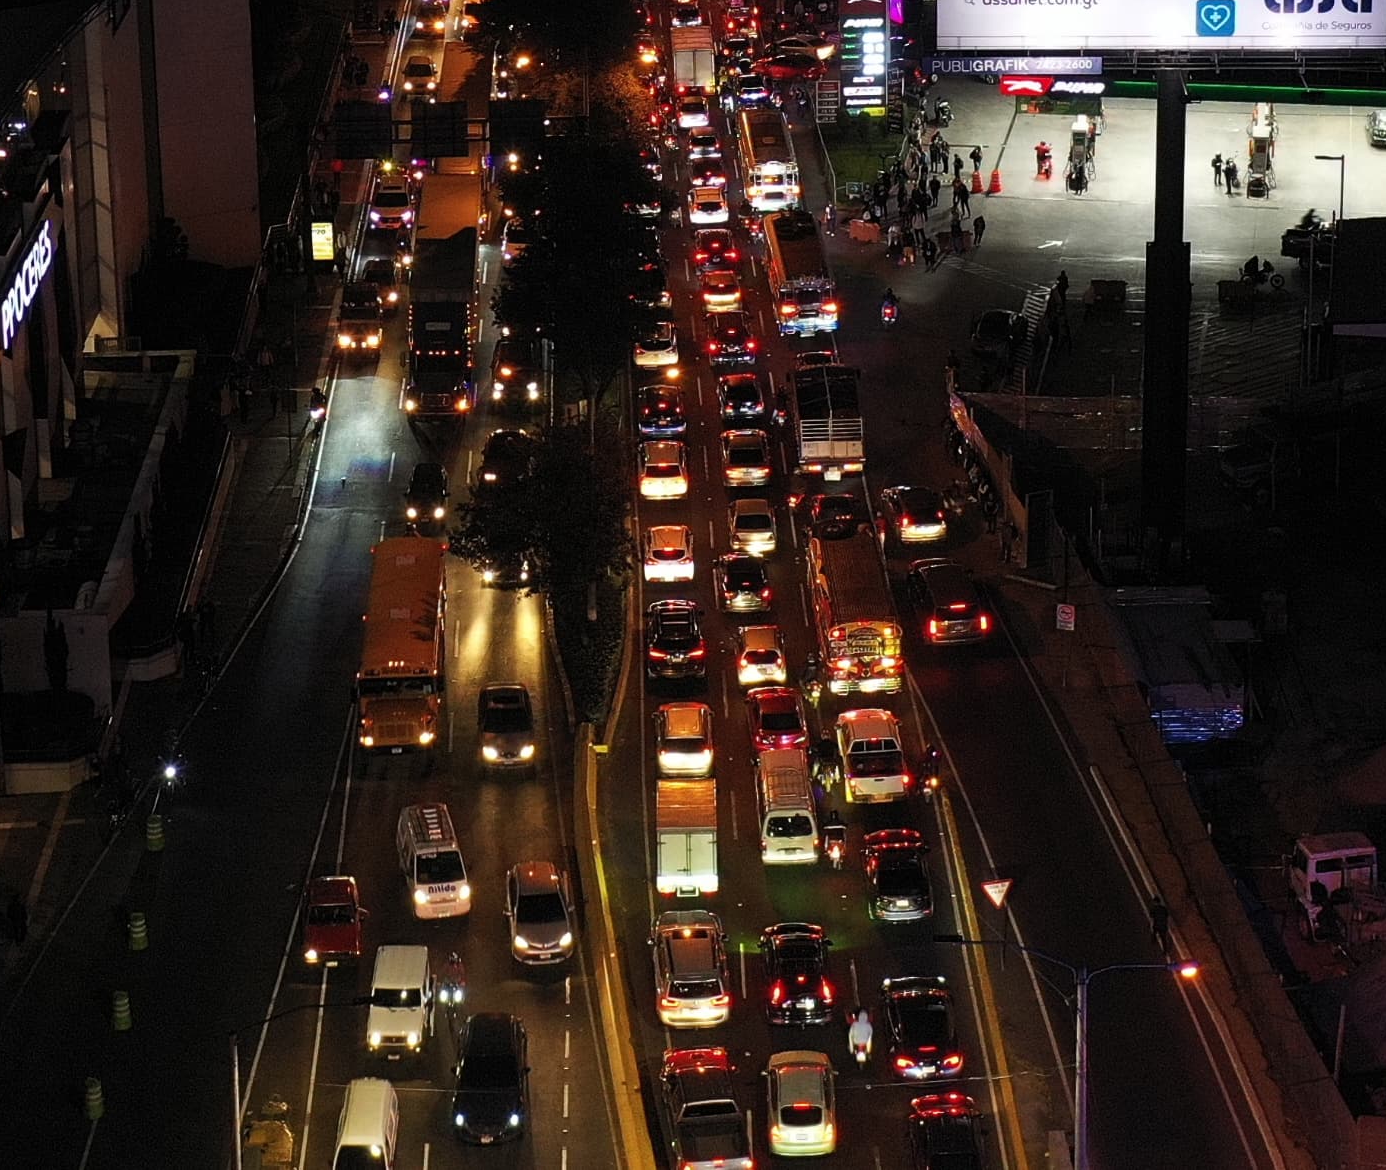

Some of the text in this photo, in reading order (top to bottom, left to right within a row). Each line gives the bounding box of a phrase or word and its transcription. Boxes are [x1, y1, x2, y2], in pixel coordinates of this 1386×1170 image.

[1315, 21, 1329, 30] de
[1331, 20, 1373, 31] Seguros
[932, 59, 1029, 73] PUBLIGRAFIK
